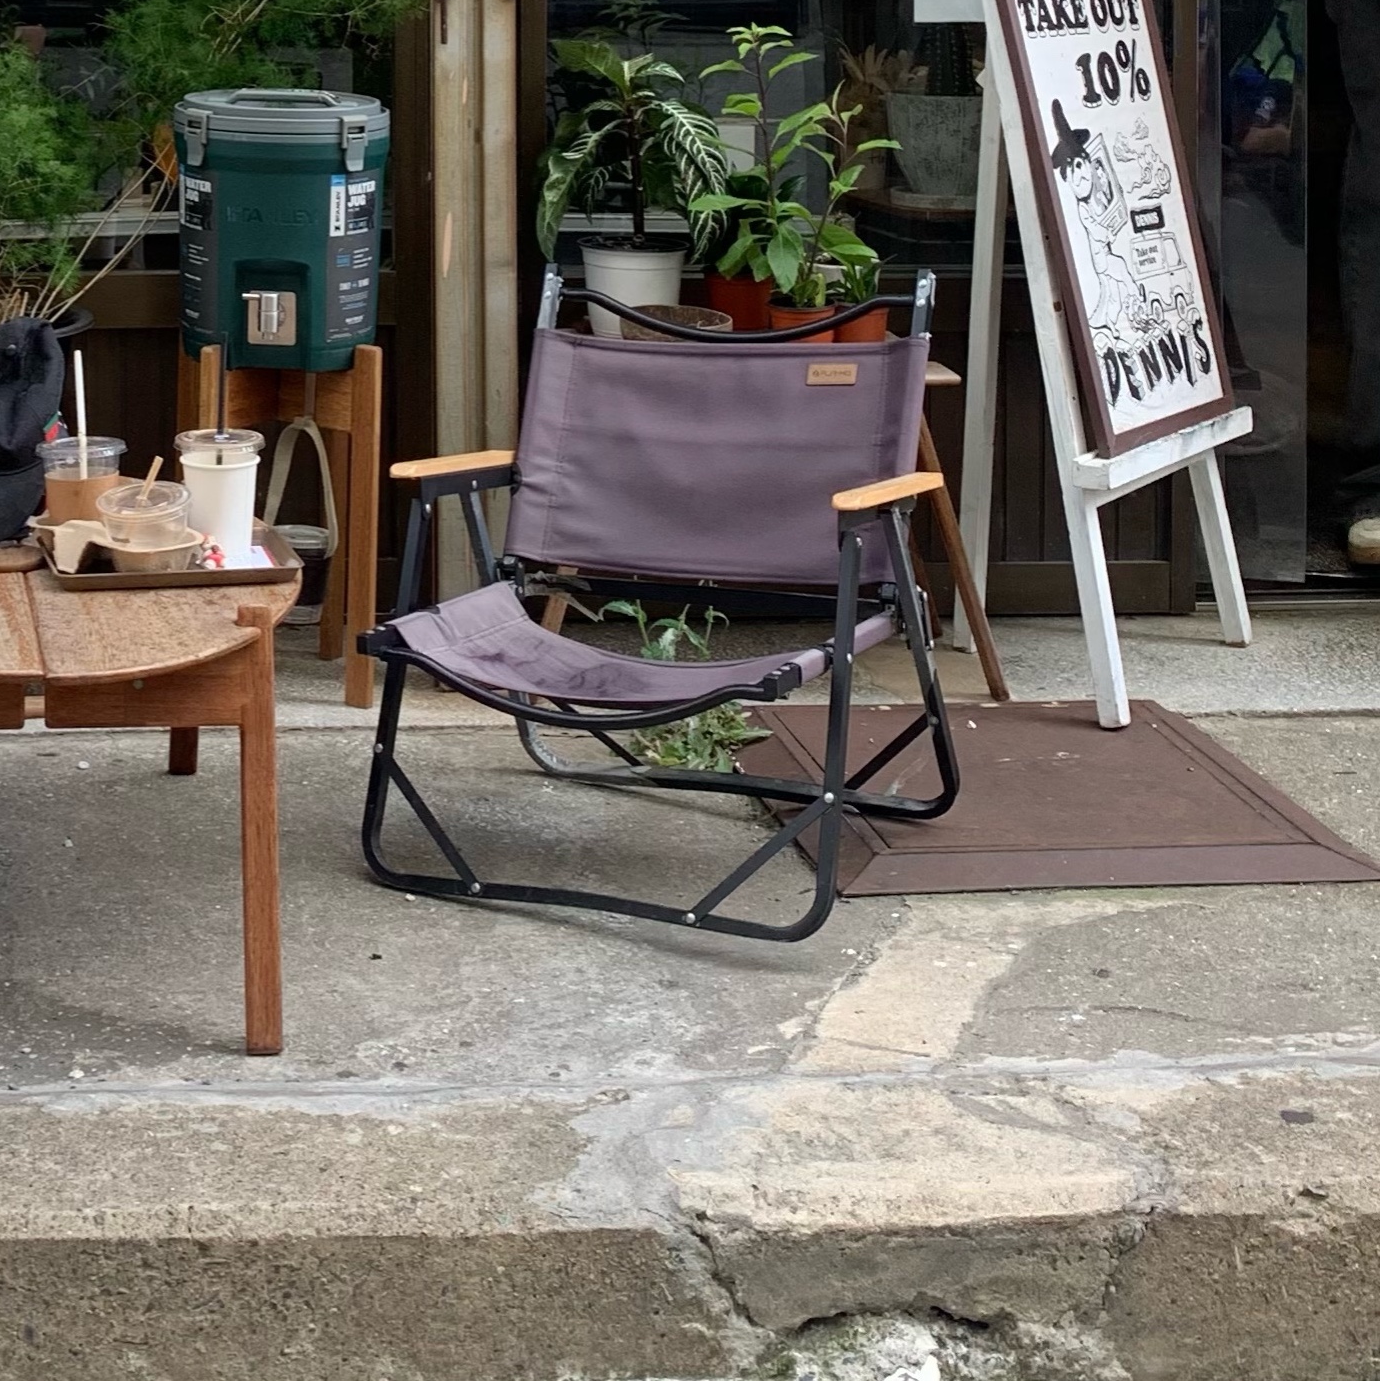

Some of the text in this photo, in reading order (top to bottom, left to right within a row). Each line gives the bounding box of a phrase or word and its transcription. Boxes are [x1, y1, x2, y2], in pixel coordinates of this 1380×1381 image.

[1075, 39, 1152, 108] 10%
[347, 194, 367, 208] JUG
[348, 180, 376, 196] WATER
[1095, 313, 1211, 407] DENNIS
